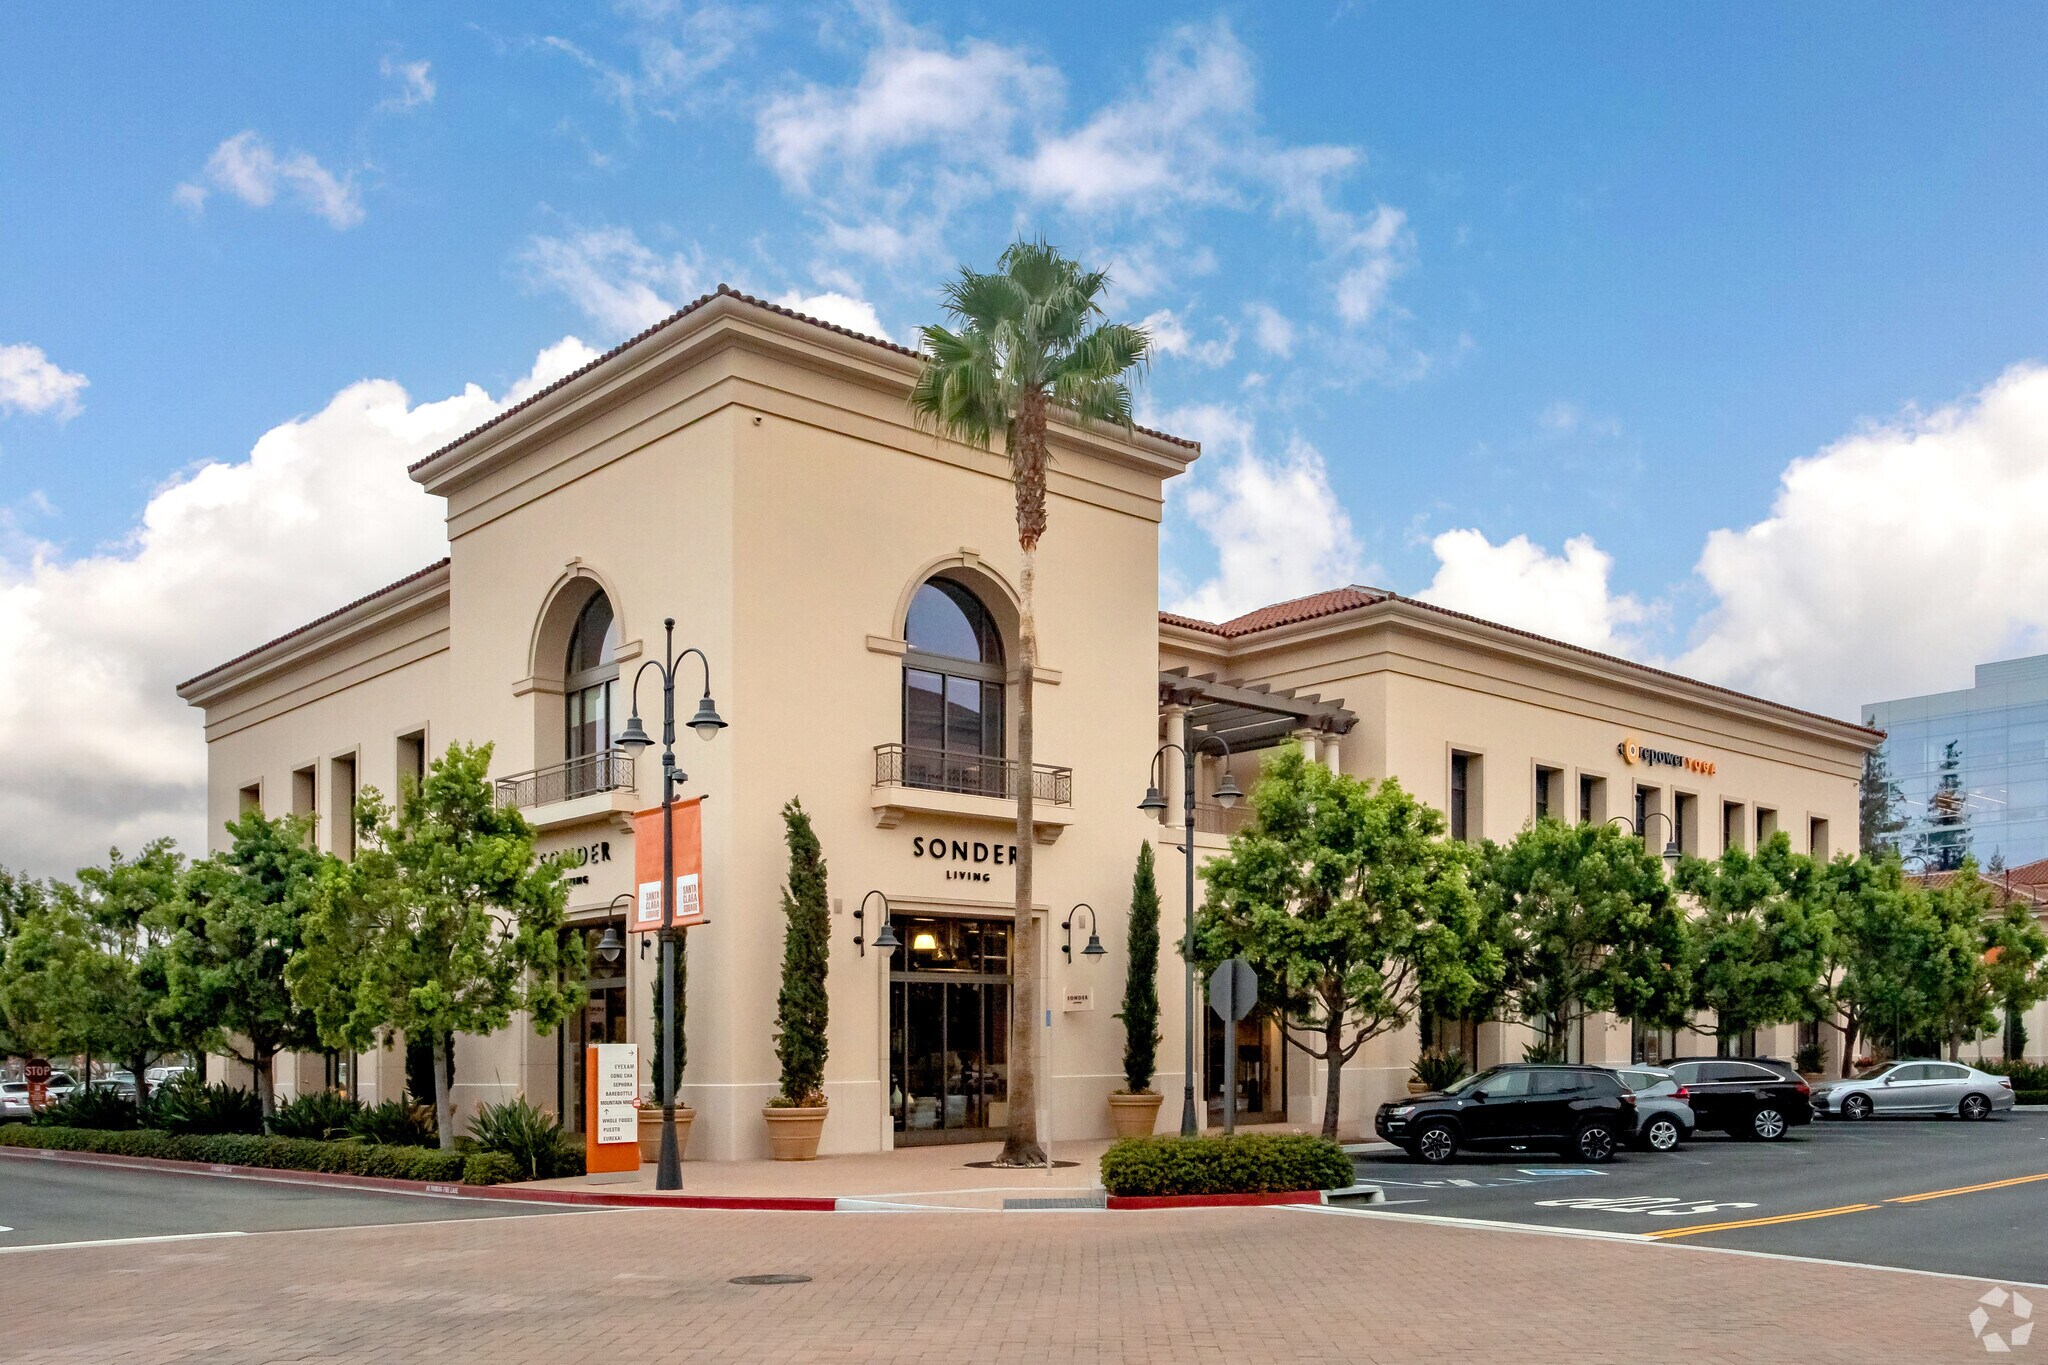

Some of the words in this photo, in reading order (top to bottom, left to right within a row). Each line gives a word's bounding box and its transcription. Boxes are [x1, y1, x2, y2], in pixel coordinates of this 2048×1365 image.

[946, 870, 990, 882] LIVING
[683, 884, 697, 894] SANTA
[646, 891, 660, 901] SANTA
[683, 893, 698, 904] CLARA
[646, 901, 660, 910] CLARA
[25, 1066, 51, 1076] STOP
